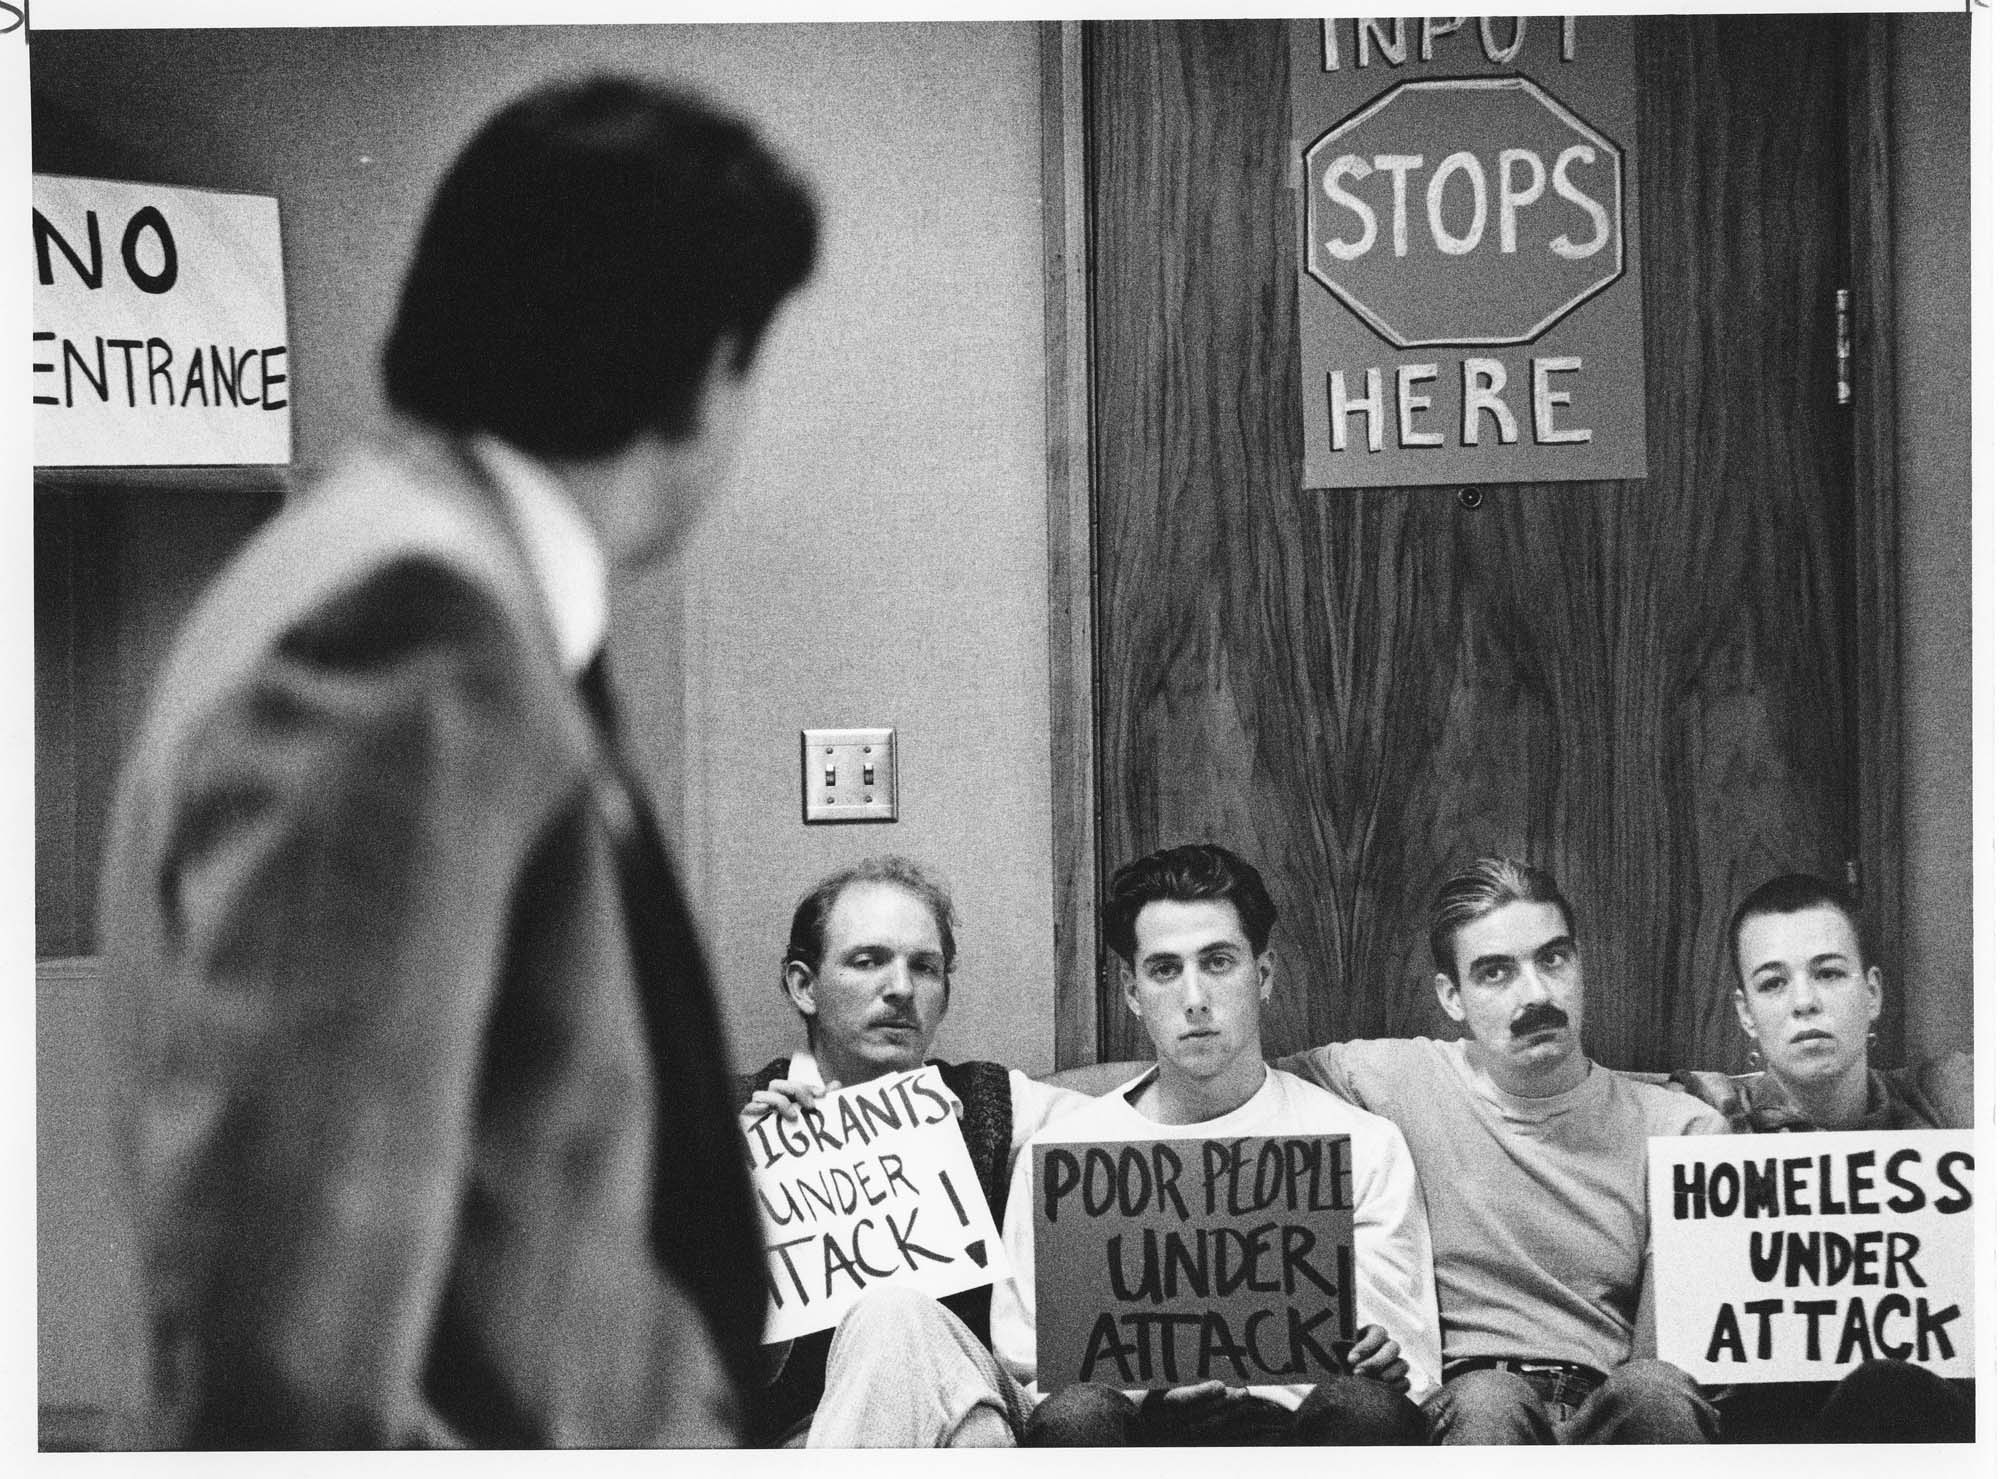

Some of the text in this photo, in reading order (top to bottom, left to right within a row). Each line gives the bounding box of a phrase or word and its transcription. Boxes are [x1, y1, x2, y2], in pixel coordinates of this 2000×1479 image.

[1323, 144, 1609, 261] STOPS
[33, 205, 179, 295] NO
[1327, 356, 1593, 453] HERE
[757, 1153, 921, 1226] UNDER
[1043, 1136, 1355, 1223] POOR PEOPLE
[1673, 1148, 1975, 1220] HOMELESS
[1107, 1221, 1339, 1305] UNDER
[1749, 1230, 1928, 1288] UNDER
[1705, 1292, 1961, 1364] ATTACK
